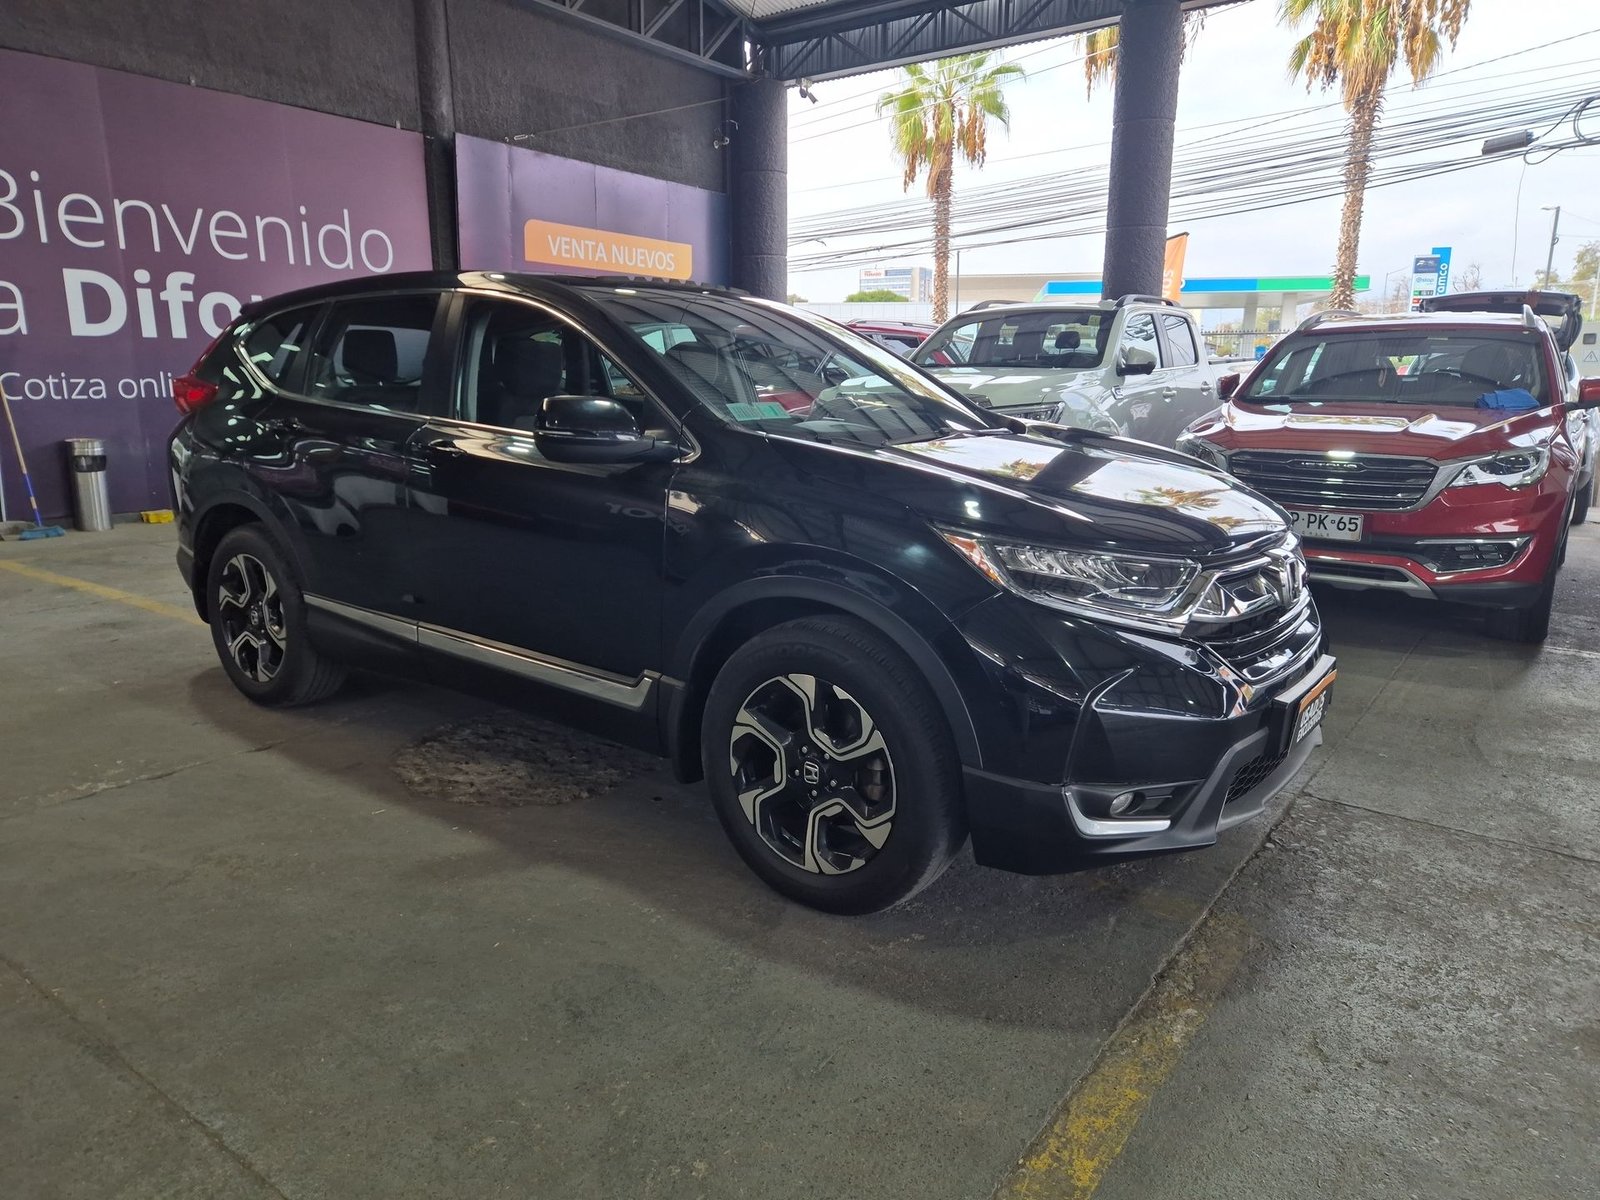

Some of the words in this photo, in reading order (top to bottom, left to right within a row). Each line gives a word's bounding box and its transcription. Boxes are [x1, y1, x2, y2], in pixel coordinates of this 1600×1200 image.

[0, 168, 394, 273] Bienvenido
[547, 234, 608, 263] VENTA
[611, 243, 676, 272] NUEVOS
[1435, 262, 1448, 295] amco
[0, 280, 28, 336] a
[62, 267, 263, 339] Difo
[0, 371, 107, 400] Cotiza
[118, 371, 174, 399] onli
